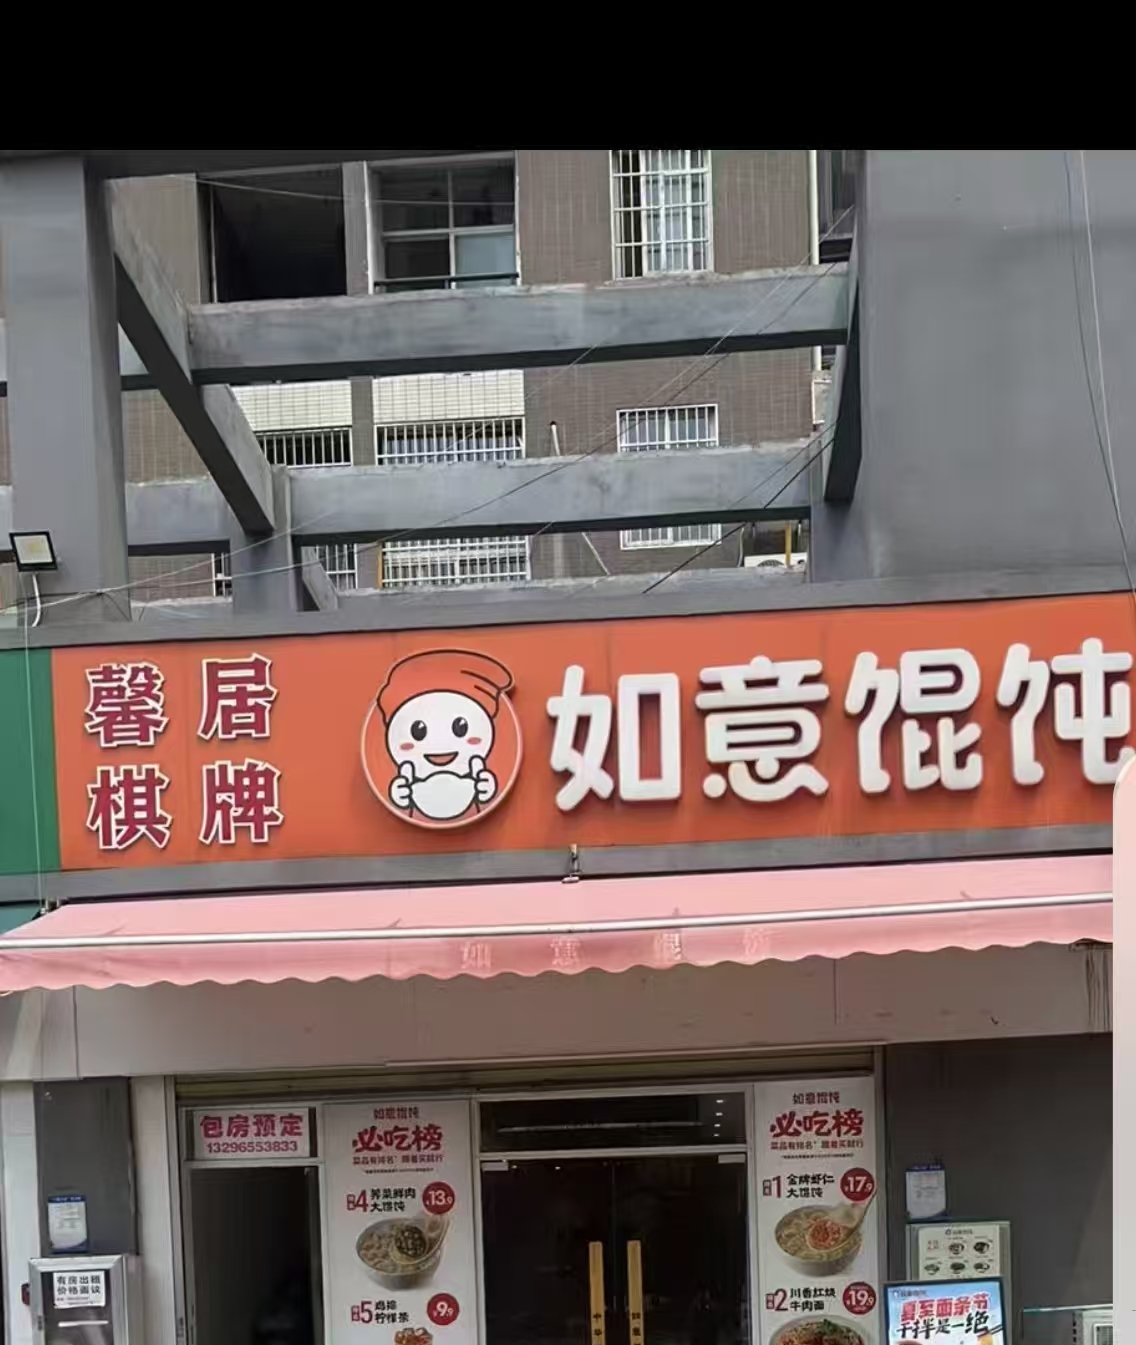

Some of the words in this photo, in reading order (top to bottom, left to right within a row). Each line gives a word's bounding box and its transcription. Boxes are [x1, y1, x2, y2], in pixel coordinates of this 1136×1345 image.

[84, 653, 279, 748] 馨居
[546, 637, 1136, 812] 如意馄饨
[87, 758, 284, 850] 棋牌
[200, 1113, 303, 1138] 包房预定
[769, 1108, 864, 1137] 必吃榜
[207, 1141, 298, 1153] 13296553833
[352, 1123, 443, 1153] 必吃榜
[786, 1173, 835, 1186] 金牌虾仁
[354, 1189, 369, 1212] 4
[786, 1187, 823, 1198] 大馄饨
[370, 1201, 405, 1212] 大馄饨
[774, 1288, 789, 1311] 2
[790, 1300, 824, 1311] 牛肉面
[901, 1292, 990, 1321] 夏至面条节
[361, 1300, 373, 1324] 5
[896, 1310, 990, 1340] 干拌是一绝
